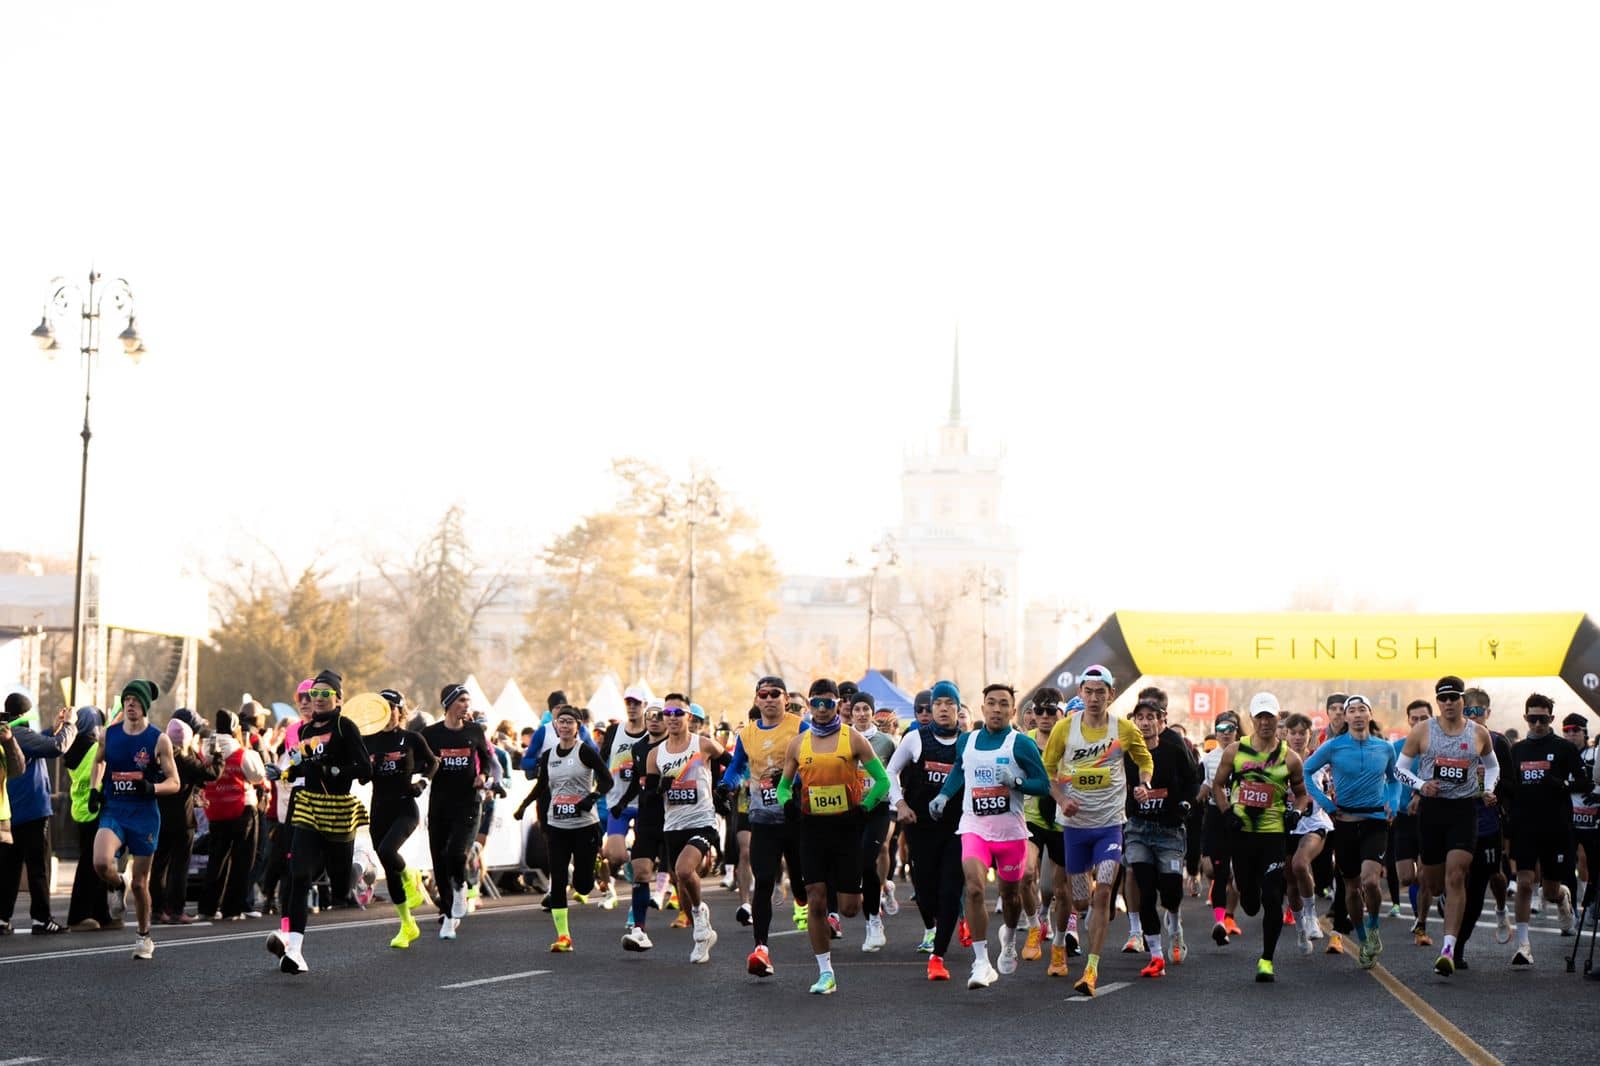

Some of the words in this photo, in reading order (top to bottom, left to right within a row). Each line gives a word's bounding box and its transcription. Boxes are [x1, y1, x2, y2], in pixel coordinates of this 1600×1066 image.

[1255, 636, 1438, 660] FINISH
[1194, 693, 1211, 714] B
[443, 757, 469, 766] 1482
[928, 771, 948, 783] 107
[1440, 766, 1463, 778] 865
[1524, 769, 1545, 780] 863
[113, 781, 137, 791] 102
[1079, 775, 1104, 785] 887
[814, 795, 842, 808] 1841
[1243, 790, 1268, 802] 1218
[975, 796, 1007, 810] 1336
